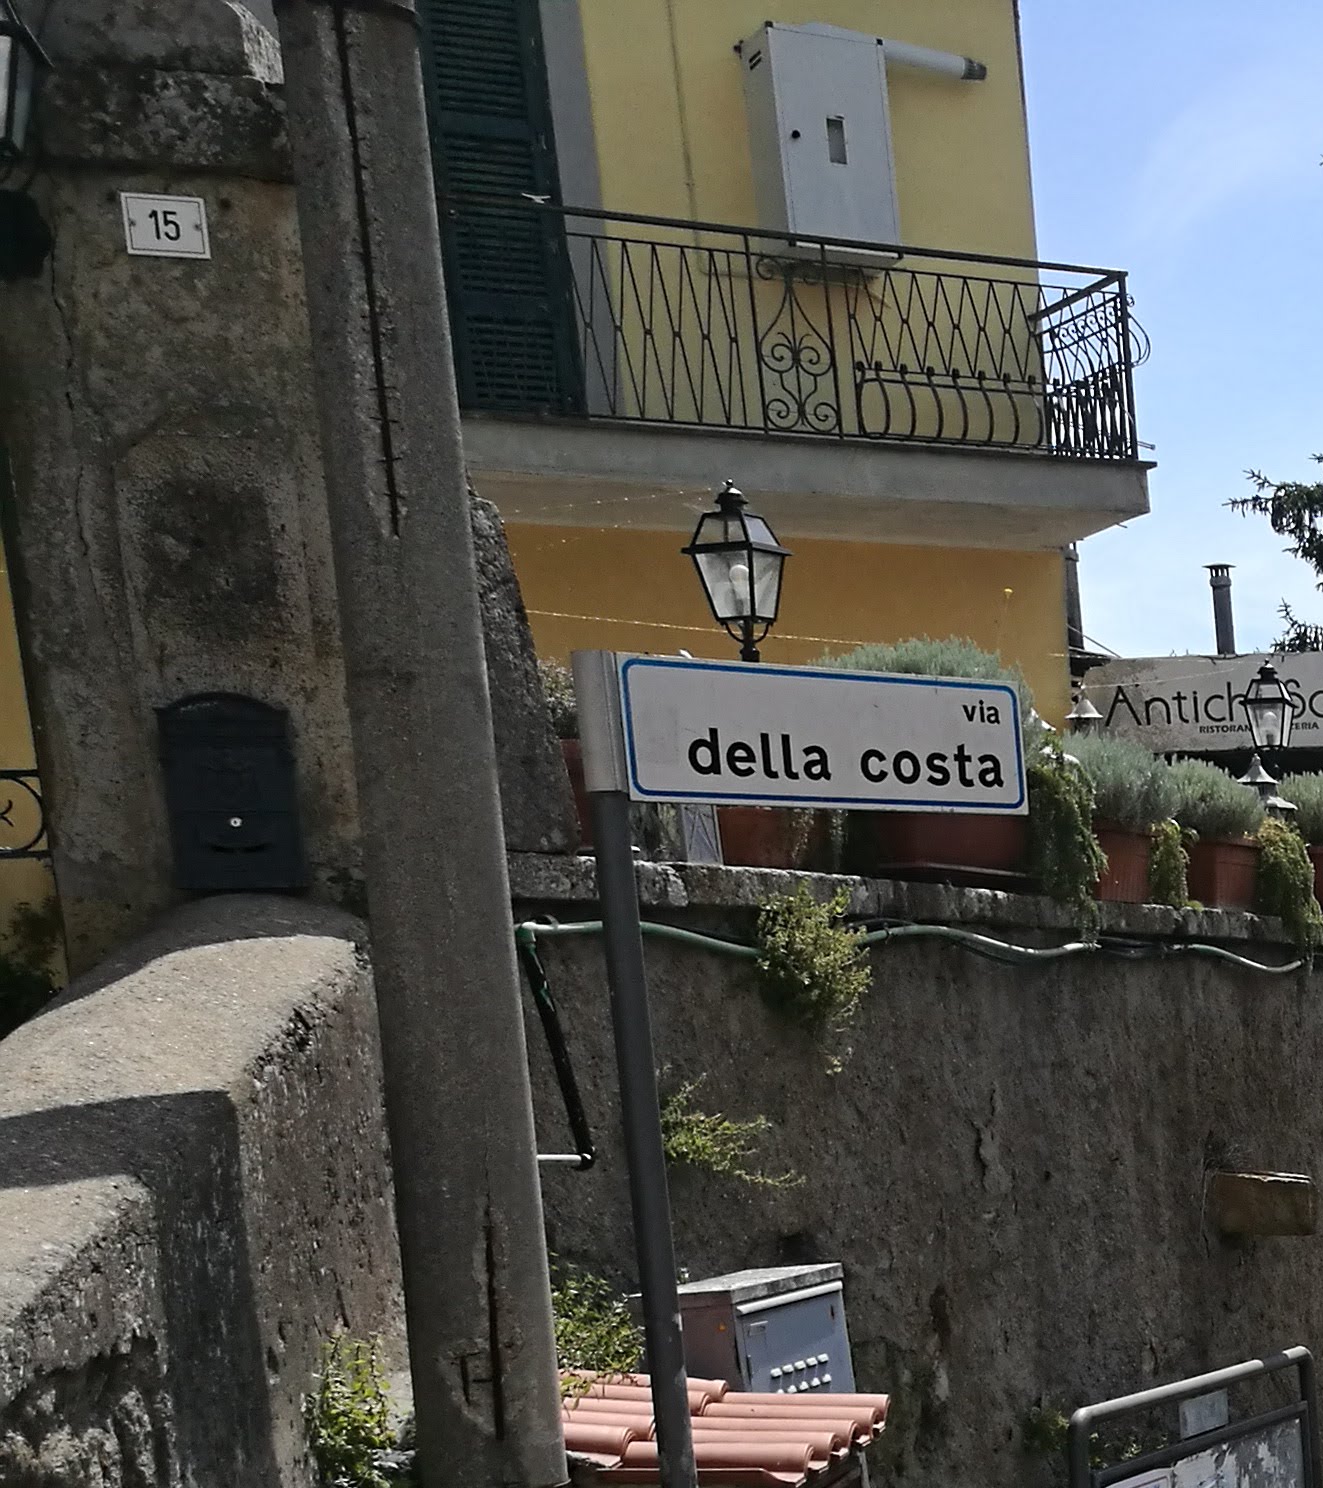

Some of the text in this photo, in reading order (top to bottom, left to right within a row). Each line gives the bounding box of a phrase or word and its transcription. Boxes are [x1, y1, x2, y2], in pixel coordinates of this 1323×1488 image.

[148, 209, 181, 241] 15
[962, 699, 1000, 724] via
[1105, 681, 1247, 727] Antich
[687, 727, 1004, 788] della costa
